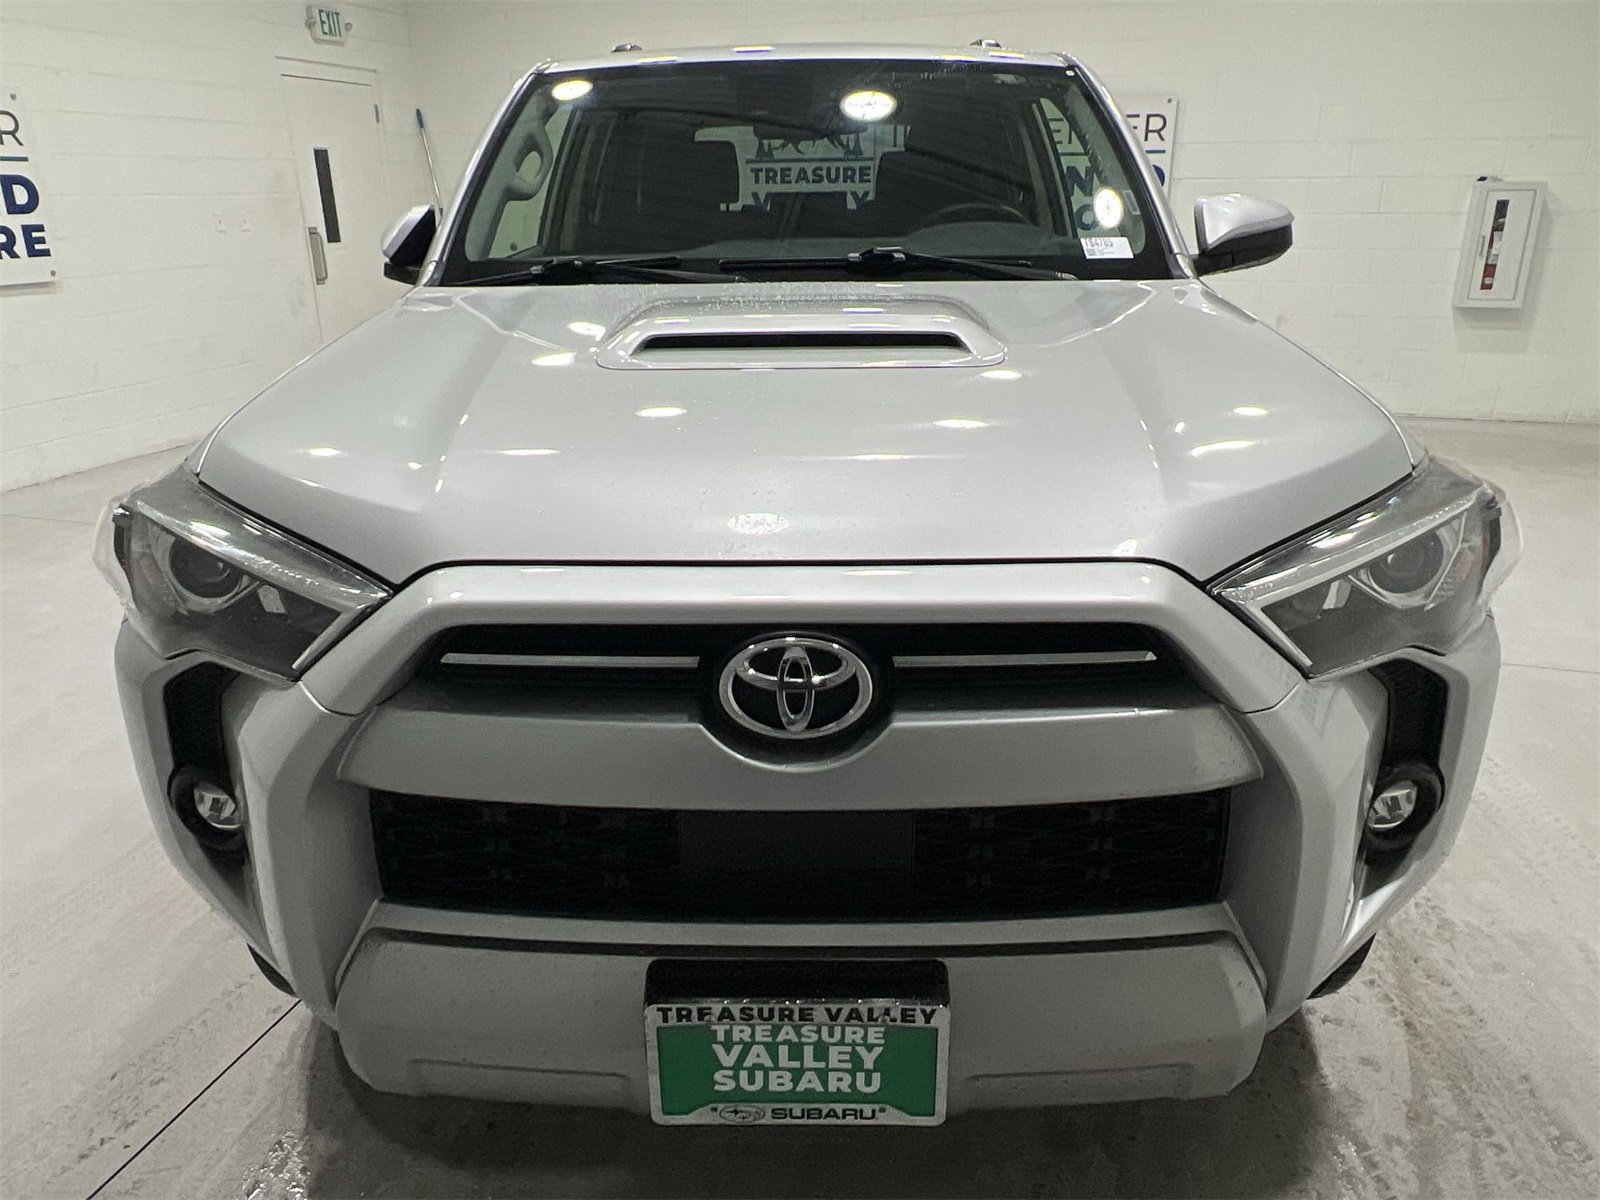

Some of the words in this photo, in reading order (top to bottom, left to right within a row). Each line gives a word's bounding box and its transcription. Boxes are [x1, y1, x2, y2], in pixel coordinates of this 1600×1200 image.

[318, 9, 341, 37] EXIT
[750, 166, 871, 184] TREASURE
[656, 1006, 815, 1023] TREASURE
[824, 1007, 937, 1025] VALLEY
[710, 1025, 885, 1044] TREASURE
[711, 1044, 885, 1070] VALLEY
[713, 1070, 881, 1093] SUBARU
[771, 1108, 876, 1120] SUBARU
